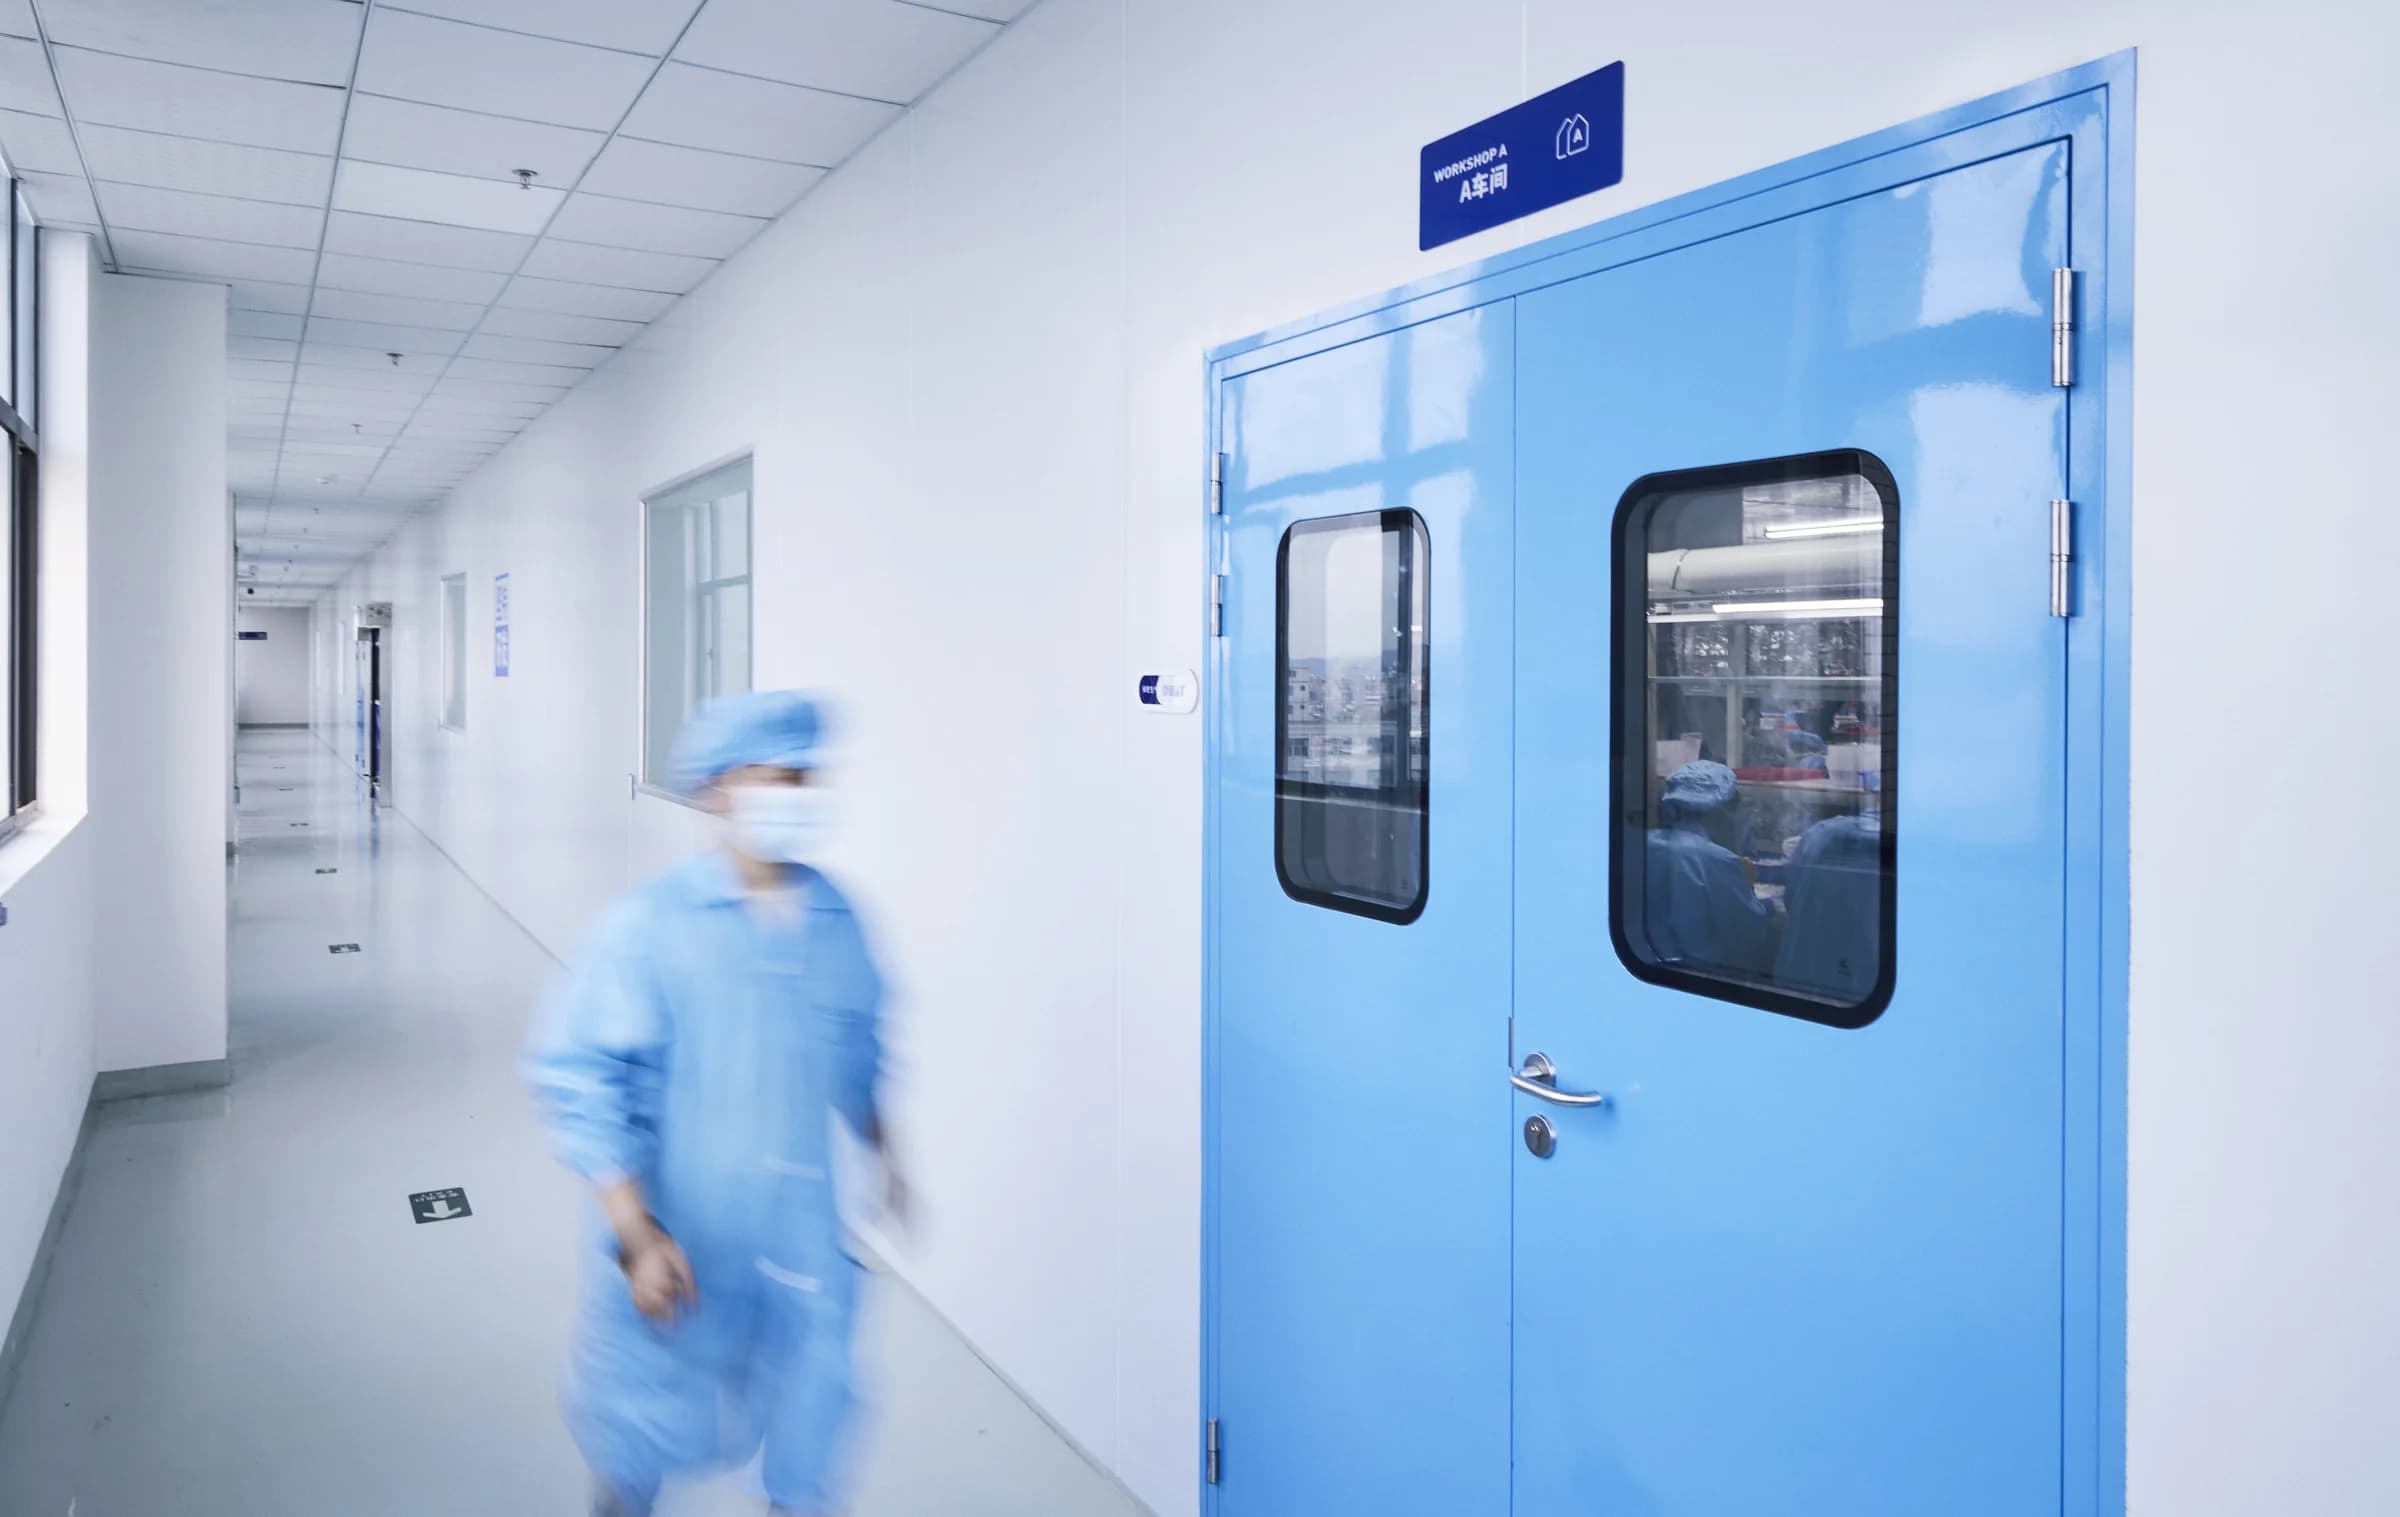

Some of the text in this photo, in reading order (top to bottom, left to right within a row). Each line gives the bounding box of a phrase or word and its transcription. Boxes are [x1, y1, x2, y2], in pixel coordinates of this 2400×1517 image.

[1572, 128, 1583, 143] A
[1434, 144, 1508, 183] WORKSHOP A
[1459, 163, 1508, 203] A车间
